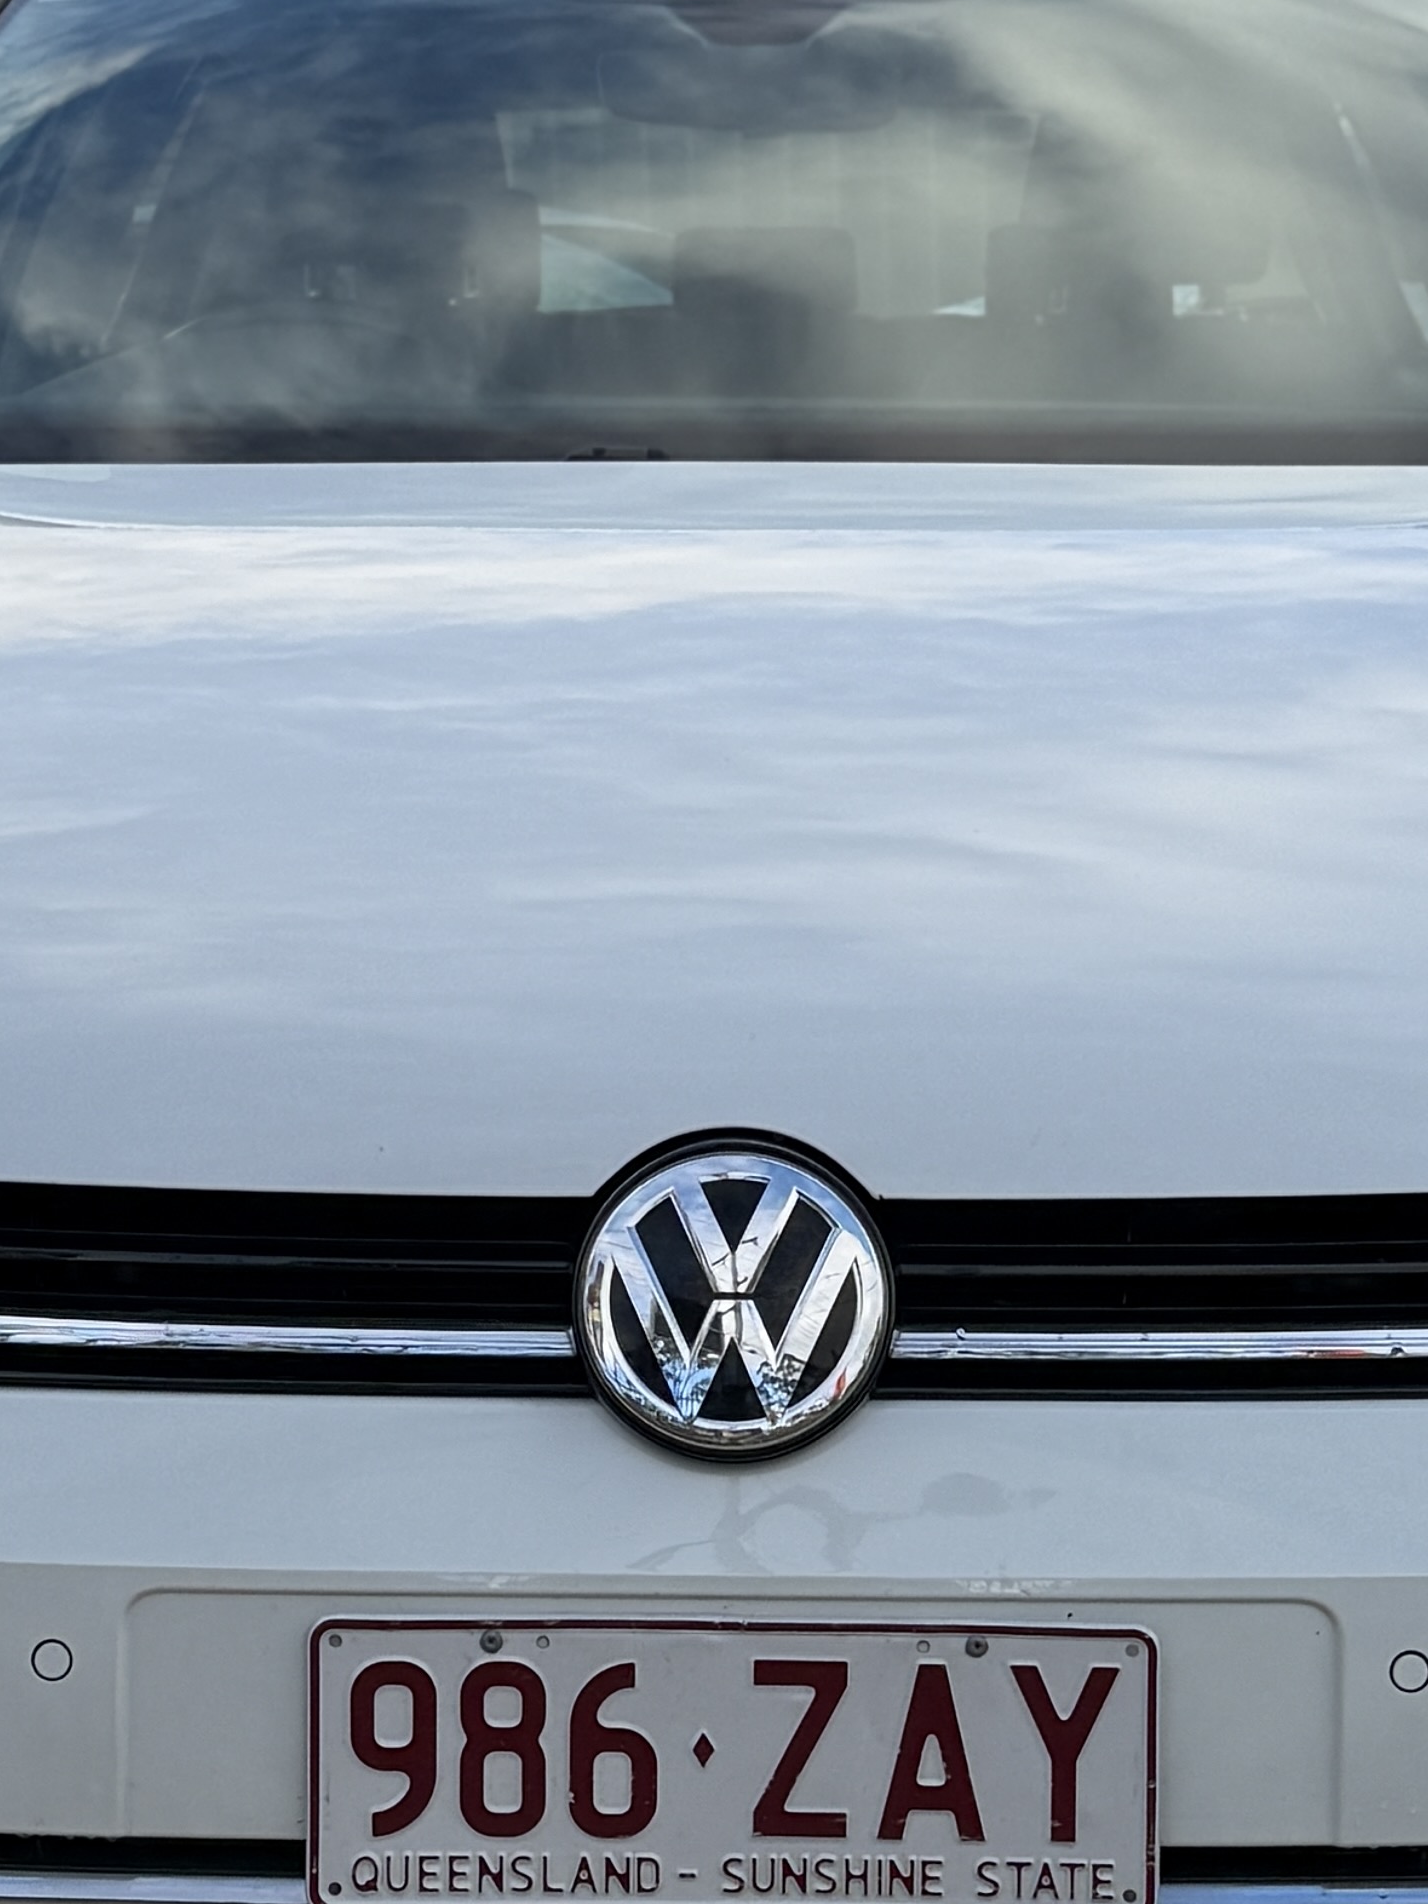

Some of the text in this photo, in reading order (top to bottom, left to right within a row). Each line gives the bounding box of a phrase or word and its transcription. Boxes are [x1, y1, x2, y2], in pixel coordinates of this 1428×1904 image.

[349, 1659, 1122, 1843] 986 ZAY
[350, 1854, 661, 1898] QUEENSLAND
[722, 1855, 946, 1900] SUNSHINE
[976, 1859, 1116, 1903] STATE
